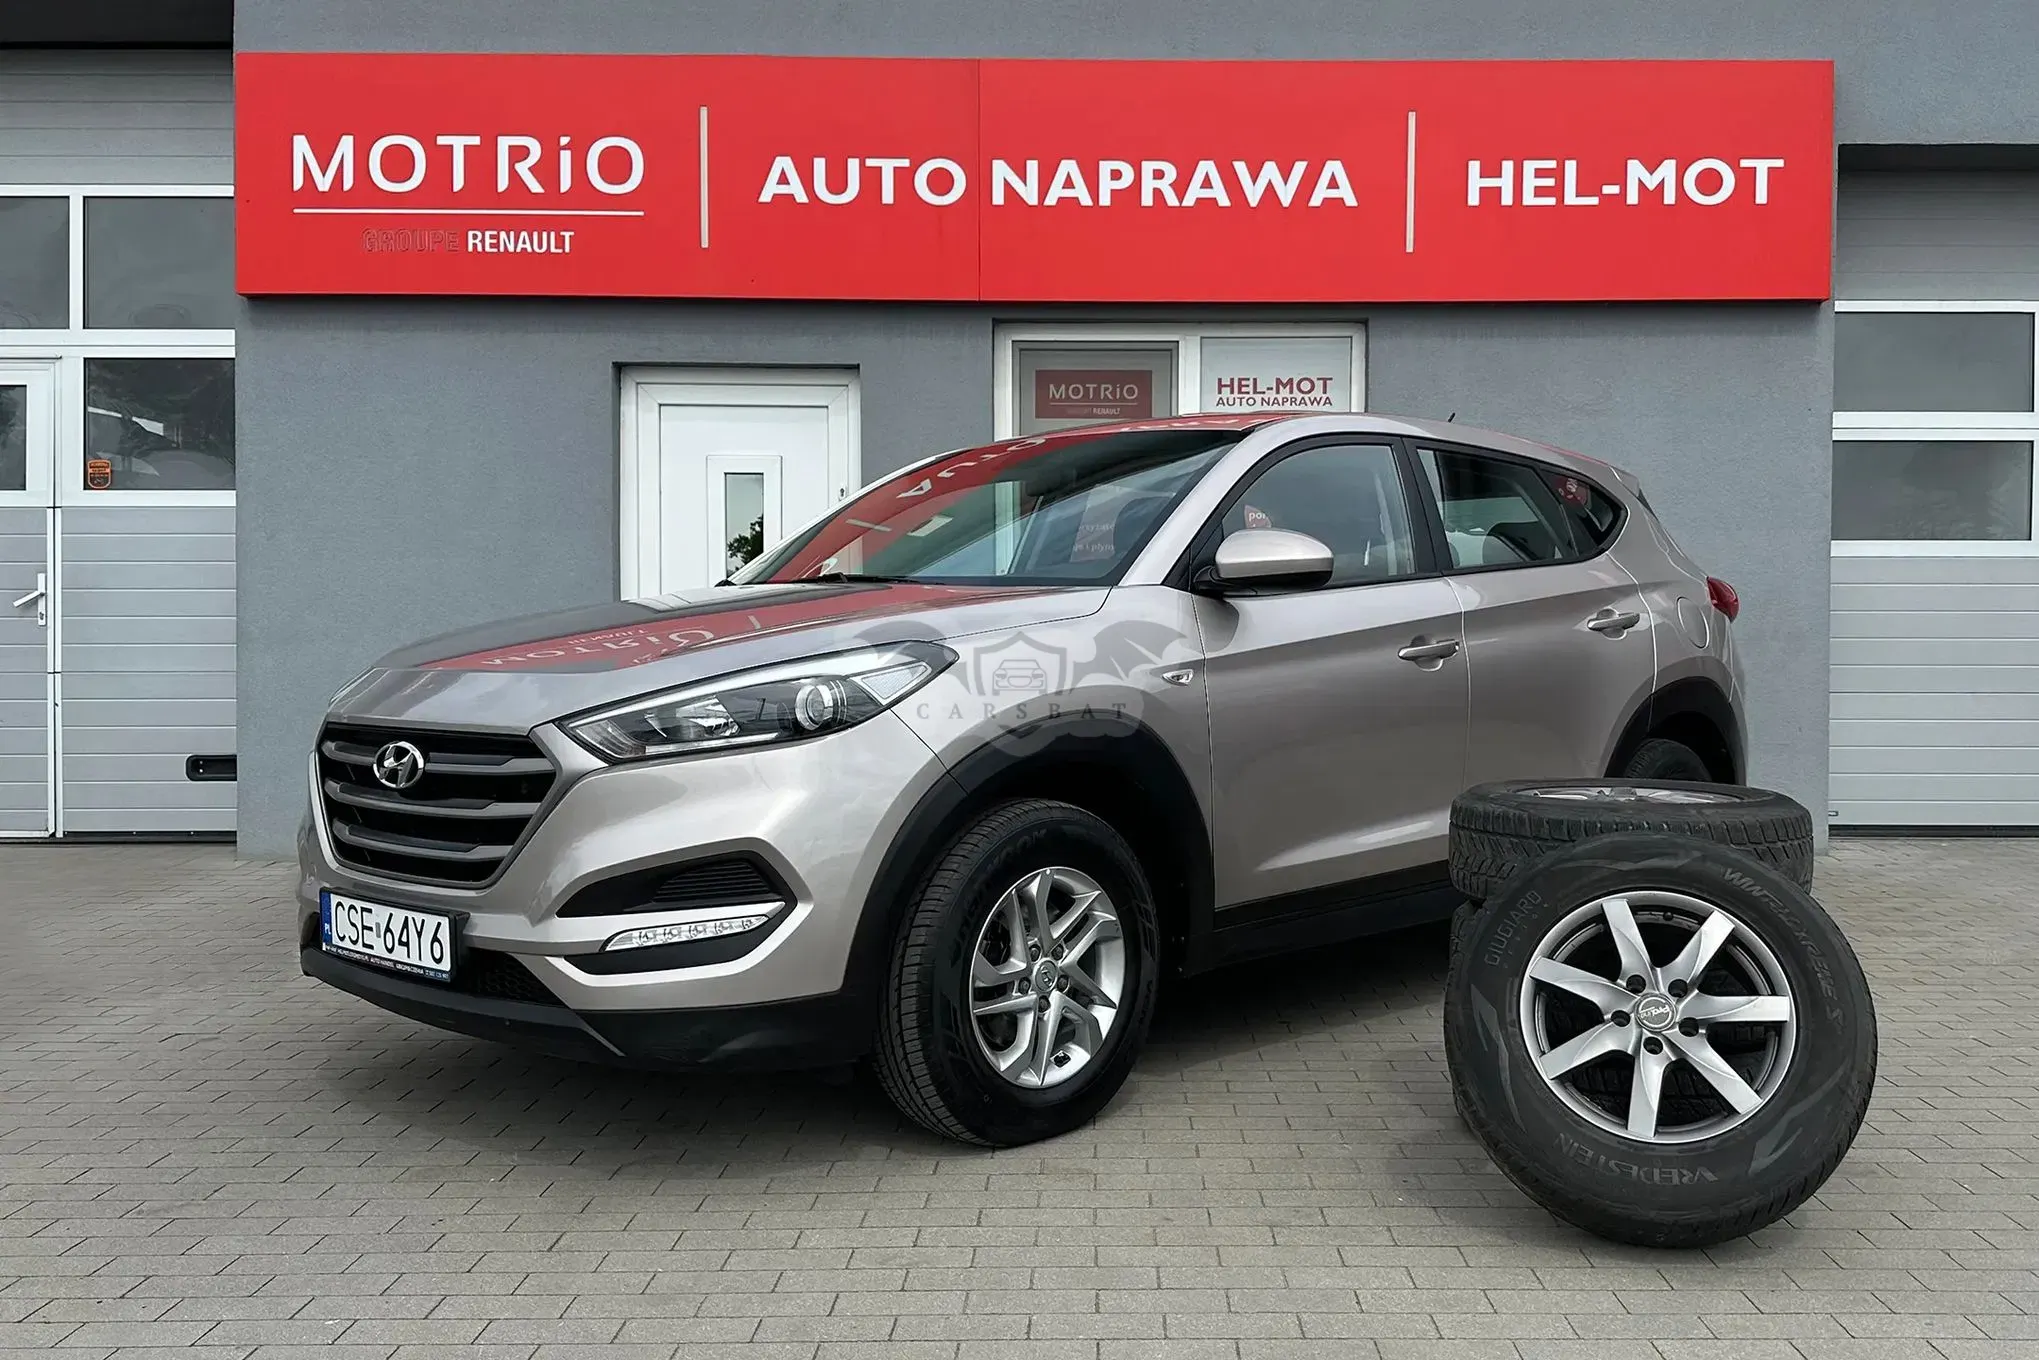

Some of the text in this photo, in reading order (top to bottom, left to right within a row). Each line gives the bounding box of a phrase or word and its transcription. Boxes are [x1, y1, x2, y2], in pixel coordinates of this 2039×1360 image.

[292, 134, 644, 194] MOTRiO
[757, 156, 1359, 207] AUTO NAPRAWA
[1467, 158, 1785, 206] HEL-MOT
[363, 227, 575, 253] GROUPE RENAULT
[1216, 377, 1333, 395] HEL-MOT
[1216, 396, 1333, 407] AUTO NAPRAWA
[324, 922, 332, 935] PL
[335, 901, 375, 950] CSE
[383, 912, 444, 965] 64Y6
